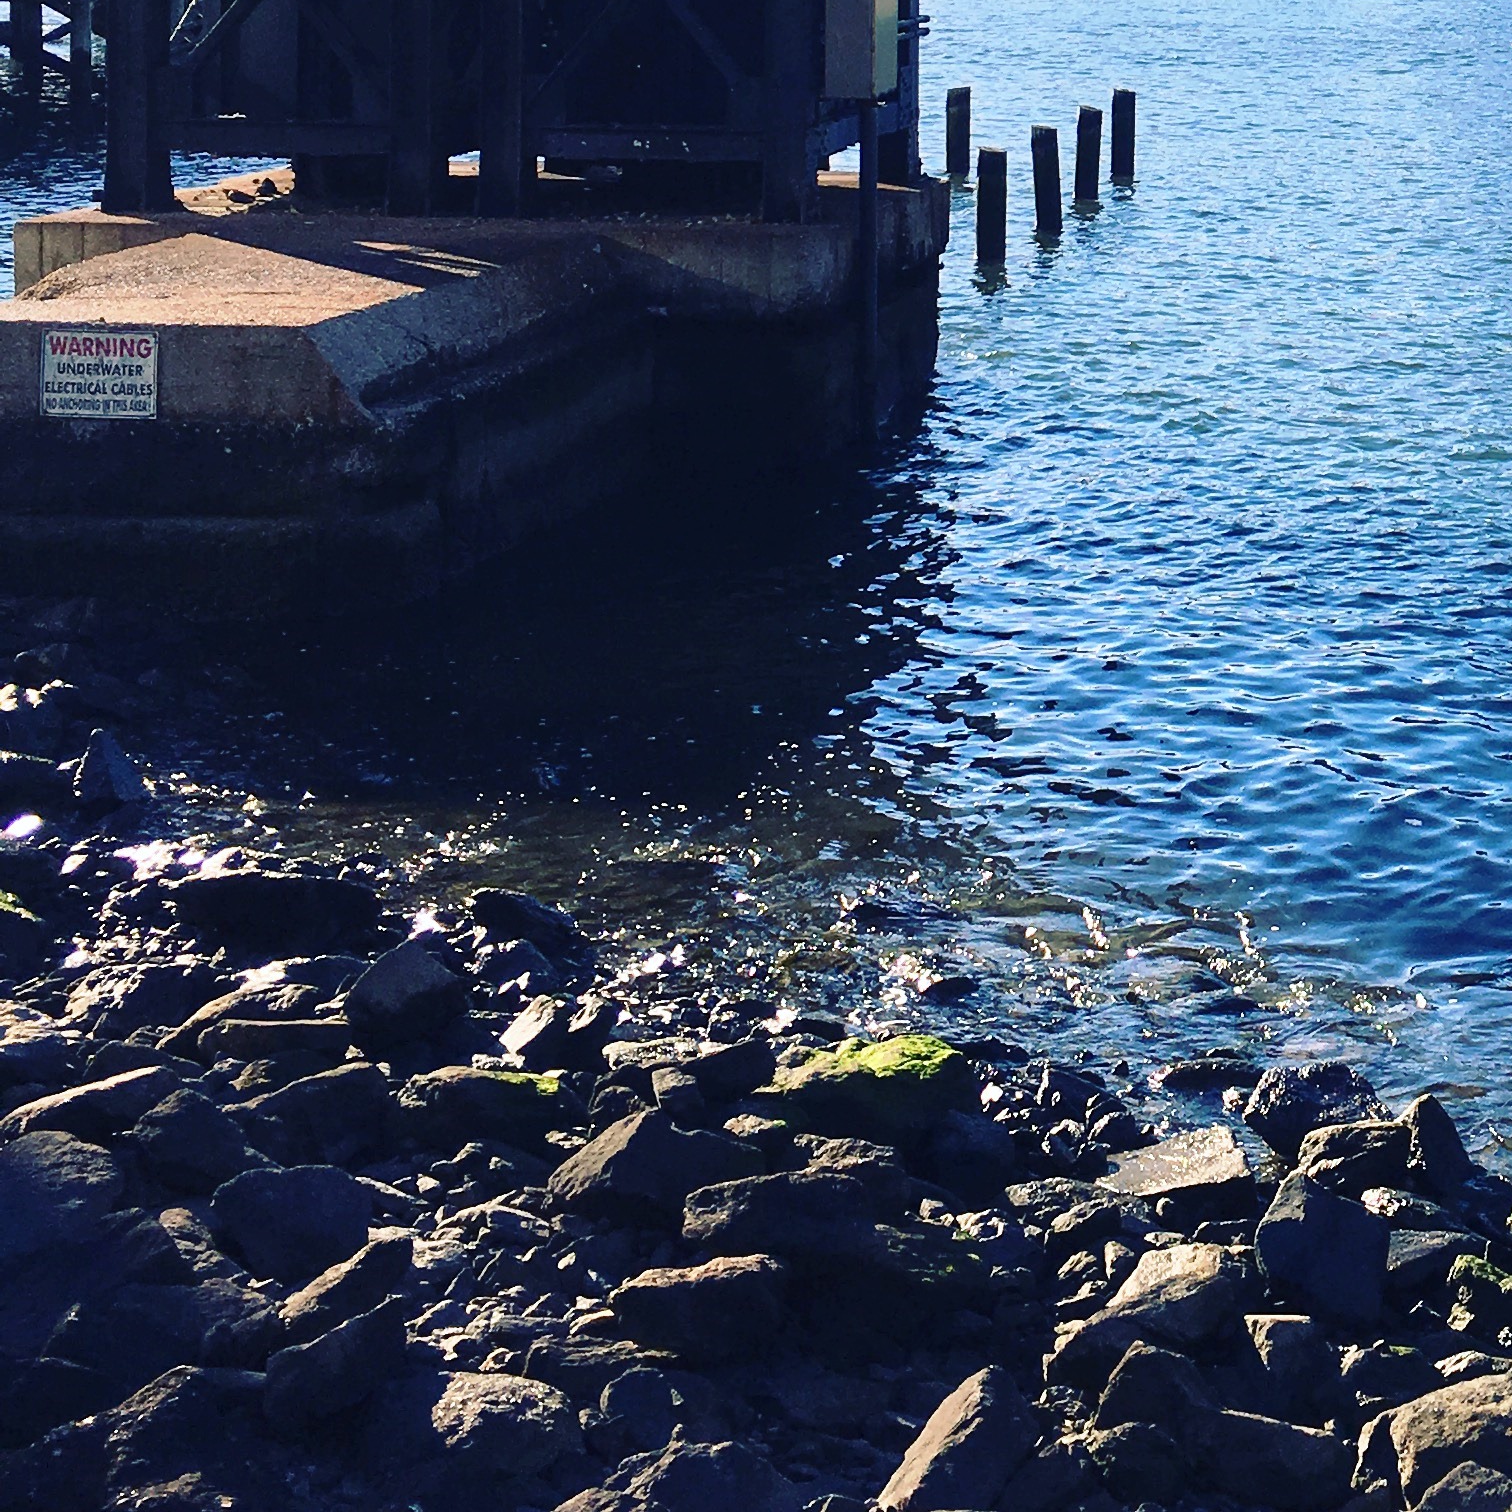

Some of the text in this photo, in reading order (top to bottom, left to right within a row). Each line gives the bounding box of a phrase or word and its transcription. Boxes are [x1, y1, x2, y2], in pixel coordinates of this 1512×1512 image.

[49, 336, 153, 358] WARNING
[57, 362, 143, 376] UNDERWATER
[45, 381, 153, 396] ELECTRICAL CABLES
[46, 397, 57, 410] NO
